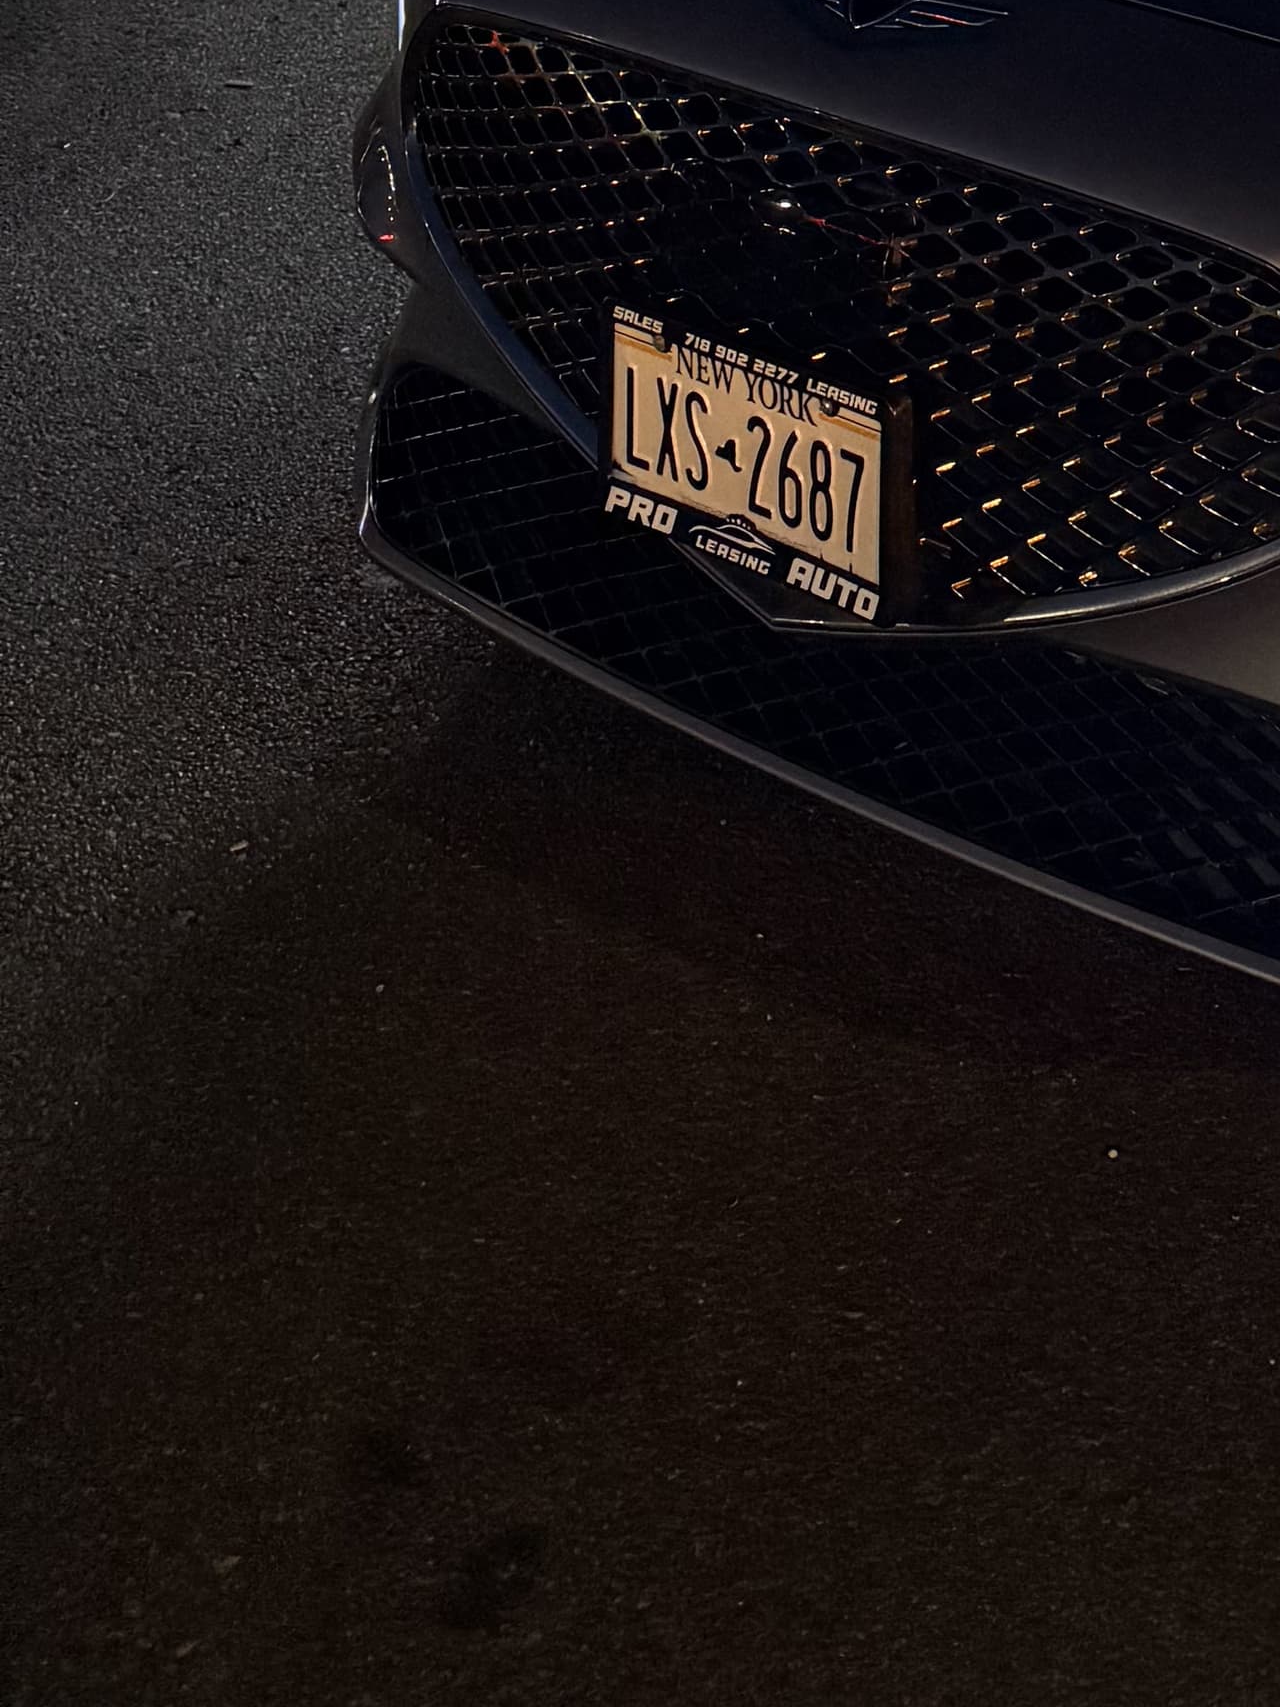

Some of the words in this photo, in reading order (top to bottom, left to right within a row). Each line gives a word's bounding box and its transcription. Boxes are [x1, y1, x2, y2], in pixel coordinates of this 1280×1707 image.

[613, 305, 664, 335] SALES
[684, 333, 710, 352] 718
[714, 344, 749, 369] 902
[753, 358, 800, 385] 2277
[675, 346, 735, 395] NEW
[746, 373, 818, 427] YORK
[806, 378, 879, 416] LEASING
[626, 366, 711, 491] LXS
[746, 415, 866, 555] 2687
[604, 485, 679, 536] PRO
[694, 534, 771, 576] LEASING
[786, 557, 880, 622] AUTO
